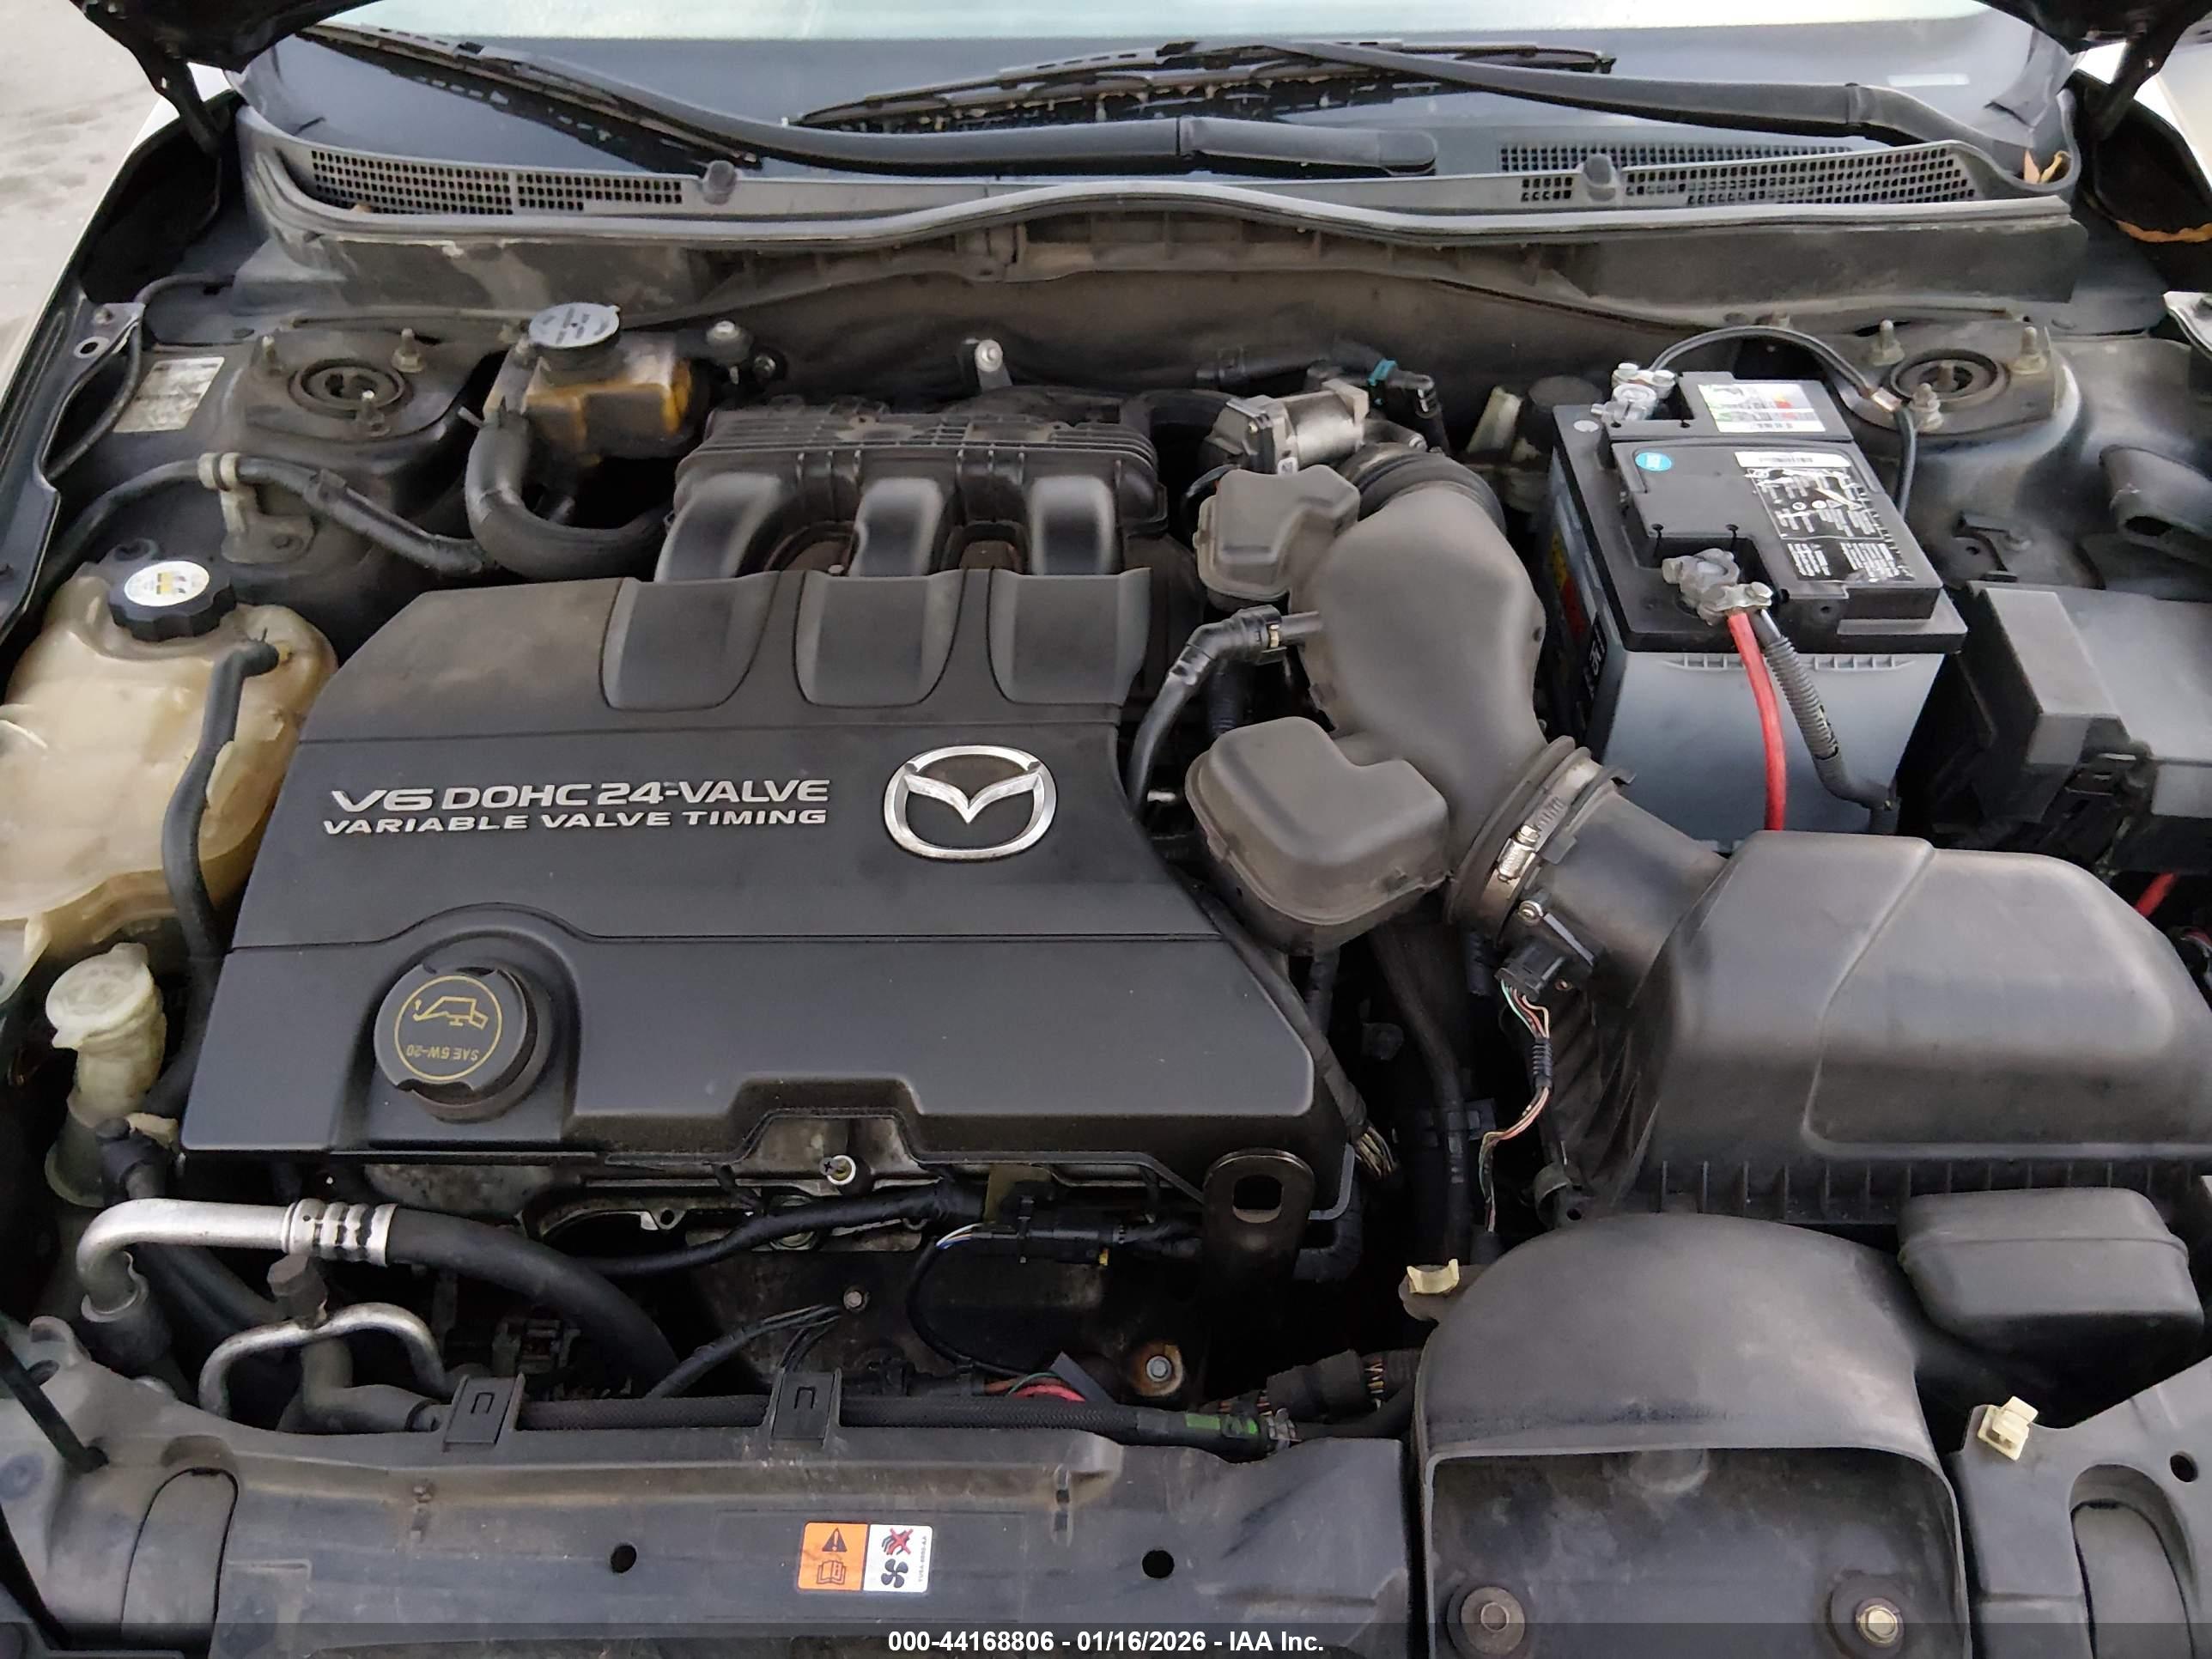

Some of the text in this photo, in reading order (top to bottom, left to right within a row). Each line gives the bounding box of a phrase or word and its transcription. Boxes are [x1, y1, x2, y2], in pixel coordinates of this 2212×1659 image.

[331, 780, 830, 811] V6 DOHC 24-VALVE
[323, 810, 828, 836] VARIABLE VALVE TIMING
[406, 1045, 480, 1061] SAE 5W-20
